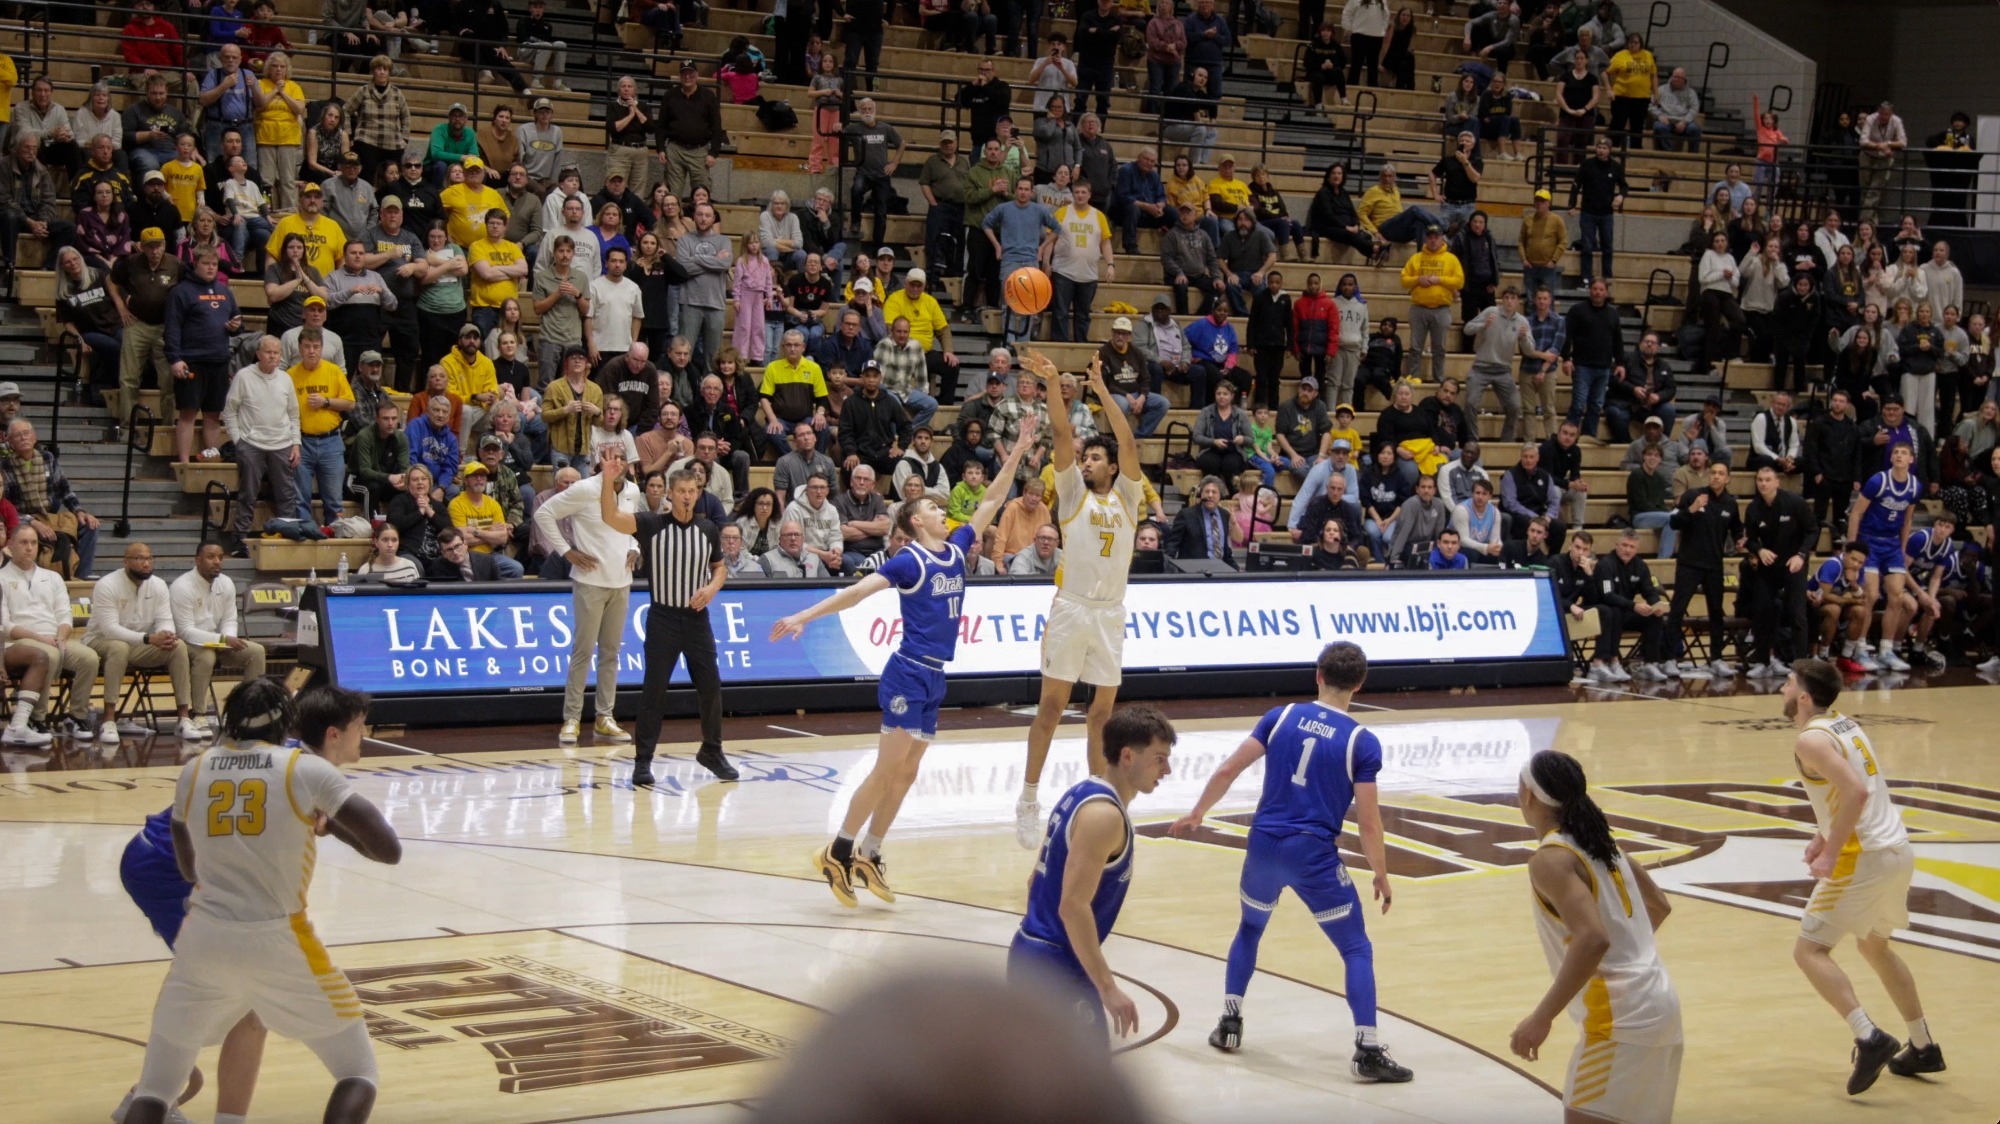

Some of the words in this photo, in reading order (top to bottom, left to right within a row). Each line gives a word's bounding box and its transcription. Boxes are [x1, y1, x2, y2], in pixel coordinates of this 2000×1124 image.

[79, 287, 106, 302] VALPO
[306, 385, 329, 394] VALPO
[1099, 532, 1115, 557] 7
[251, 589, 292, 603] VALPO
[930, 572, 964, 596] Drak
[383, 601, 750, 652] LAKESE
[986, 613, 1048, 643] TEA
[1121, 608, 1300, 641] HYSICIANS
[1330, 602, 1517, 641] www.lbji.com
[392, 657, 469, 678] BONE
[486, 656, 501, 676] &
[1297, 716, 1336, 739] LARSON
[1290, 736, 1317, 787] 1
[208, 777, 268, 837] 23
